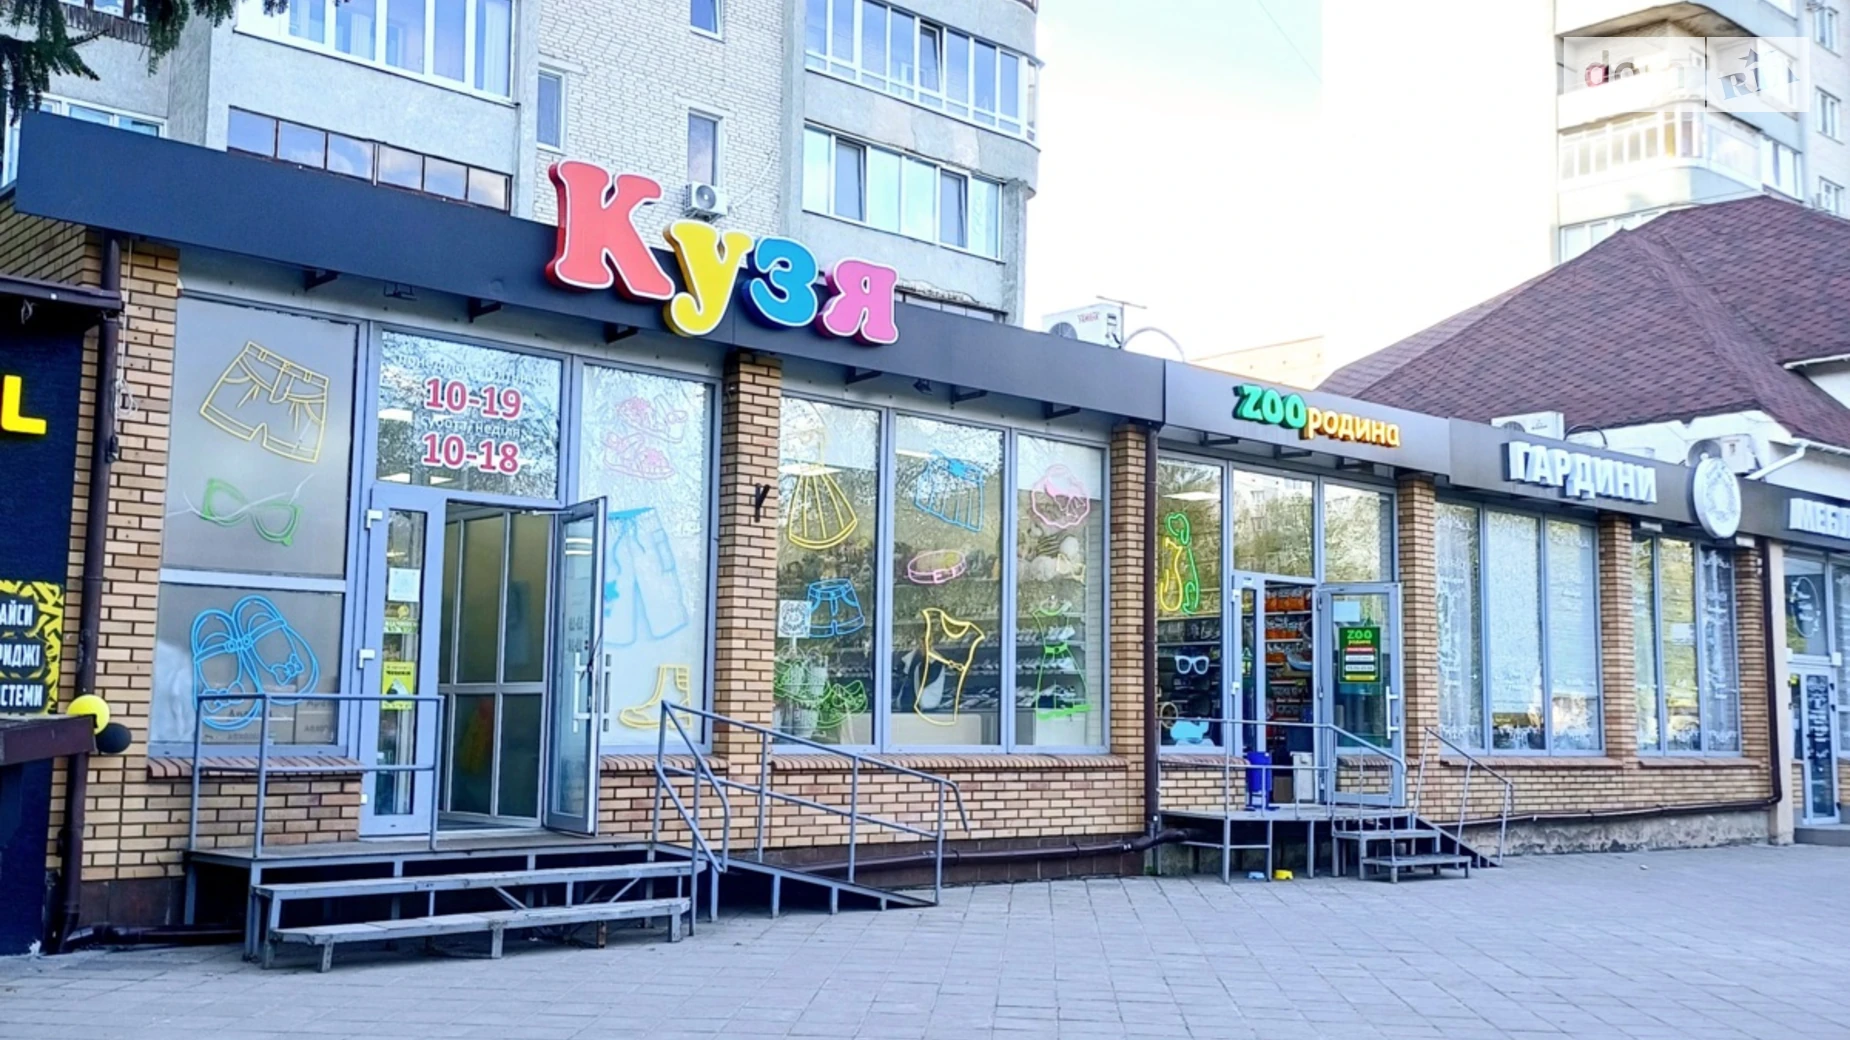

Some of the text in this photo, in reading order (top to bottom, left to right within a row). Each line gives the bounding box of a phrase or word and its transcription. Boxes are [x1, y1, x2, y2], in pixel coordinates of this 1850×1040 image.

[545, 160, 899, 345] Кузя
[1, 375, 47, 435] L
[424, 377, 523, 419] 10-19
[421, 433, 520, 474] 10-18
[1506, 441, 1657, 503] ГАРДИНИ
